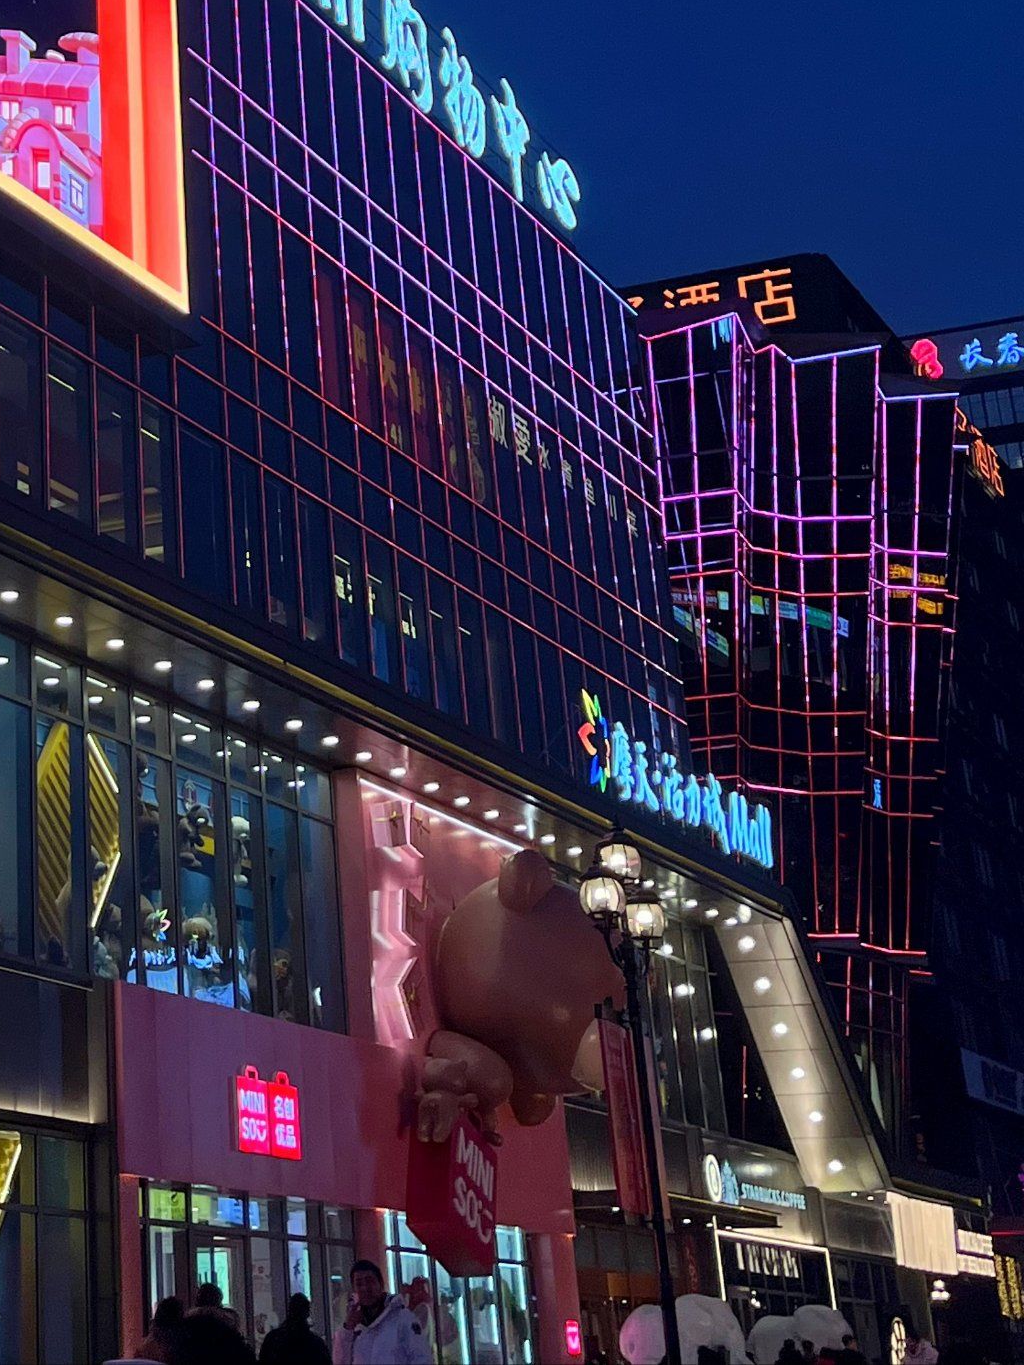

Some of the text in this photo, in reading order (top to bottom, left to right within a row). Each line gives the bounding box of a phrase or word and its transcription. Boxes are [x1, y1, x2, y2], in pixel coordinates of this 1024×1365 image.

[240, 1088, 265, 1113] MINI
[274, 1095, 295, 1121] 名创
[275, 1123, 296, 1148] 优品
[456, 1127, 494, 1201] MINI
